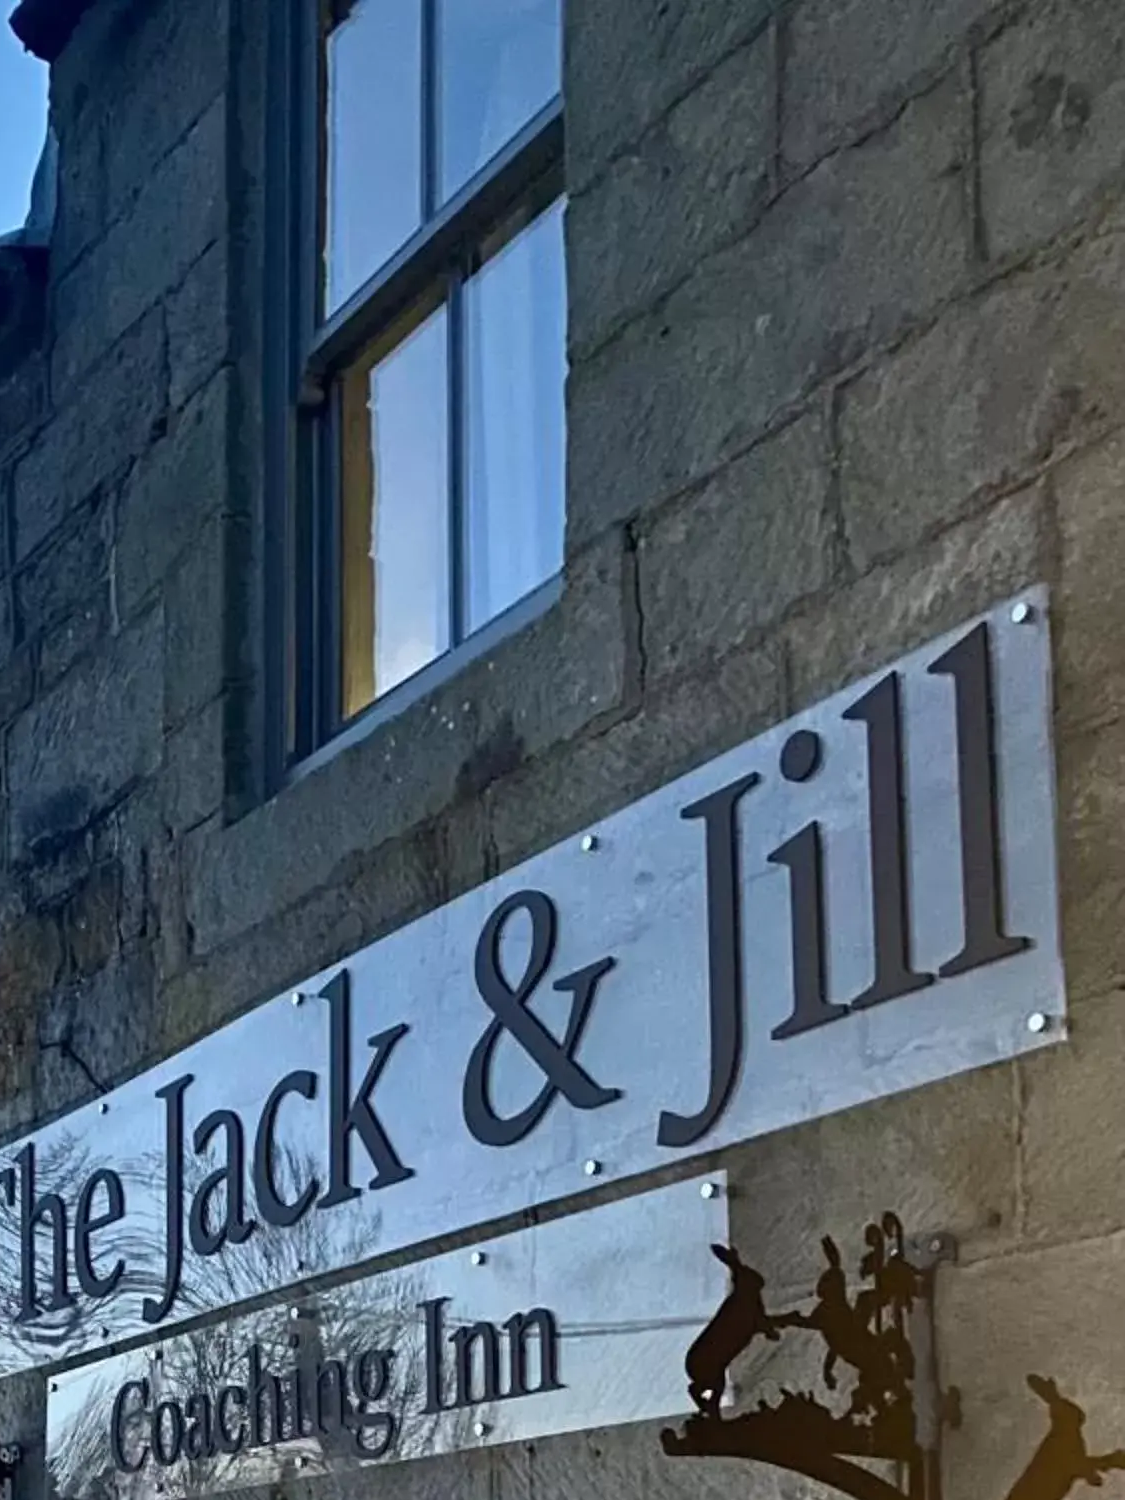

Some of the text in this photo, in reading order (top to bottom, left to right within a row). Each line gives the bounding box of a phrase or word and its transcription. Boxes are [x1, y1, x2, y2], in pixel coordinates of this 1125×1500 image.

[143, 968, 414, 1322] Jack
[462, 889, 623, 1147] &
[657, 621, 1032, 1148] Jill
[111, 1296, 566, 1473] Coaching Inn
